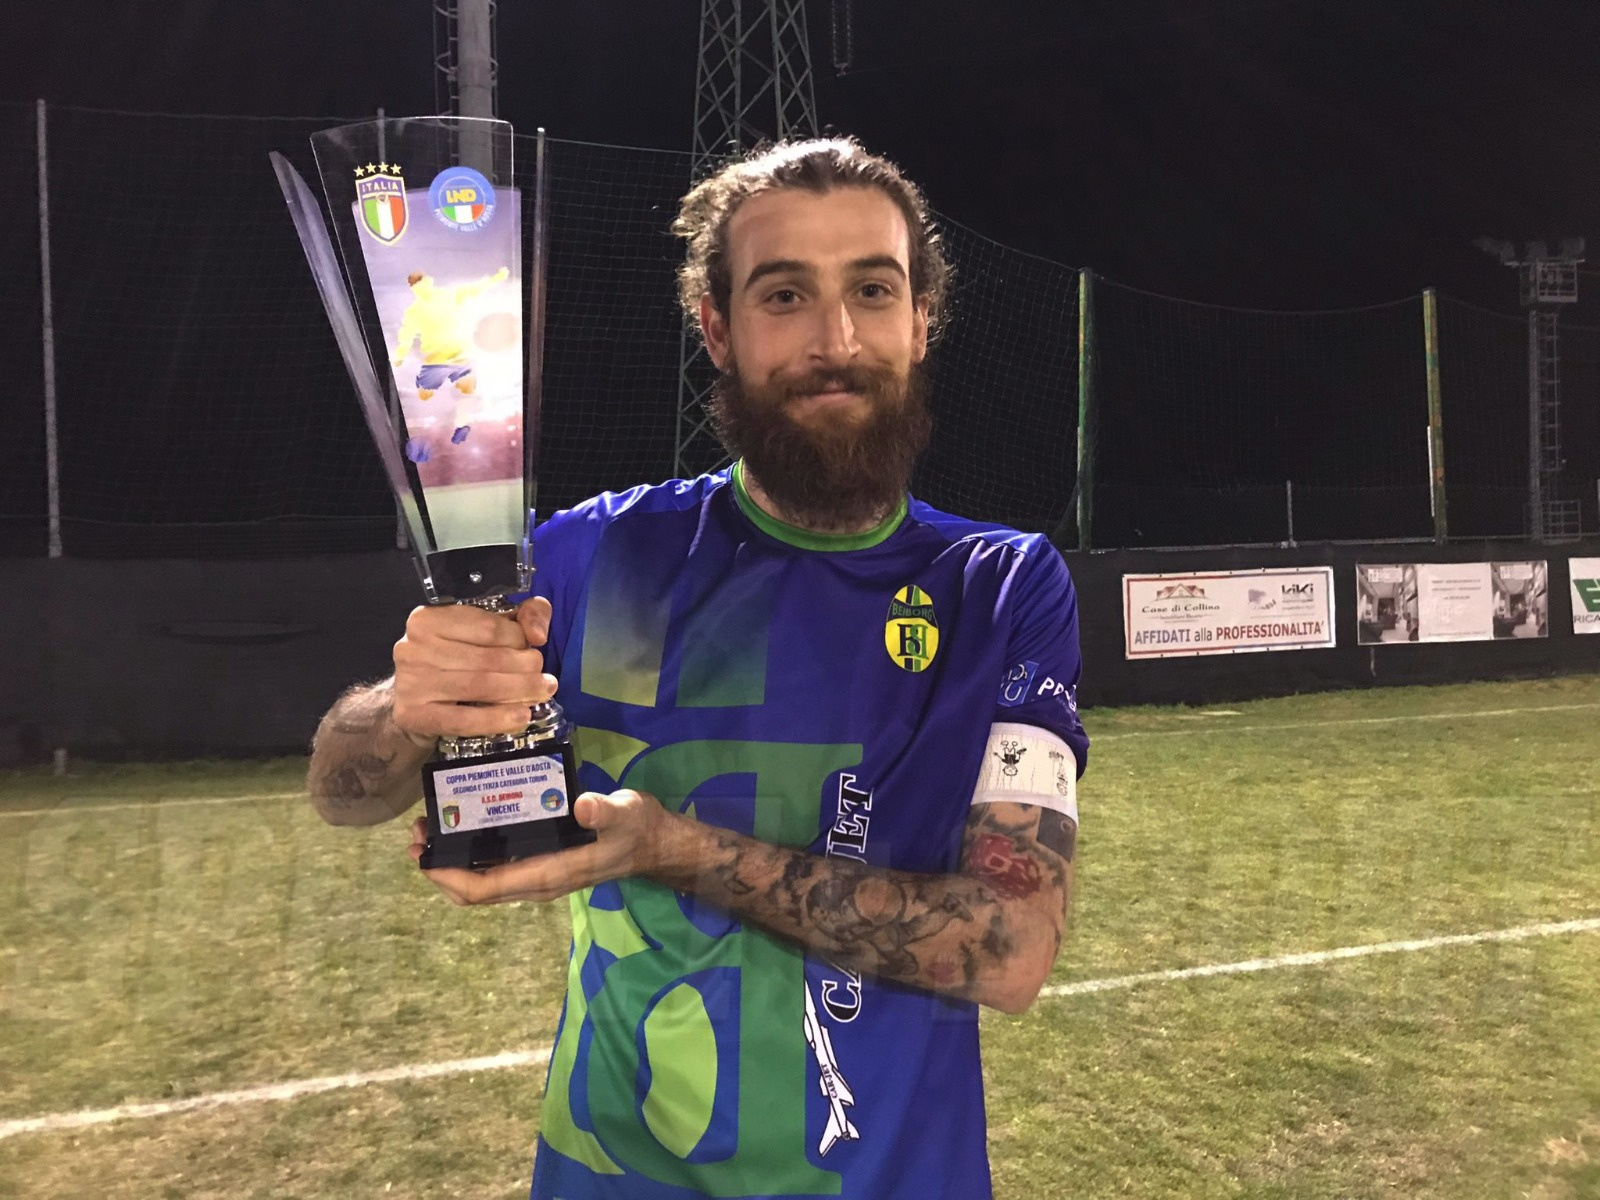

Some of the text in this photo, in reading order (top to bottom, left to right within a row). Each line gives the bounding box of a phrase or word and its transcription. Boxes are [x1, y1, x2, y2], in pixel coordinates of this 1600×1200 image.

[362, 182, 399, 193] ITALIA
[446, 188, 477, 203] LND
[892, 603, 933, 620] BEIBORG
[1142, 602, 1220, 613] Case di Collina
[1134, 629, 1190, 644] AFFIDATI
[1194, 628, 1213, 642] alla
[446, 762, 551, 785] COPPA PIEMONTE E VALLE D'AOSTA
[452, 784, 477, 795] SECONDA
[500, 777, 528, 788] CATEGORIA
[486, 803, 520, 816] VINCENTE
[821, 1063, 838, 1099] CAR-JET
